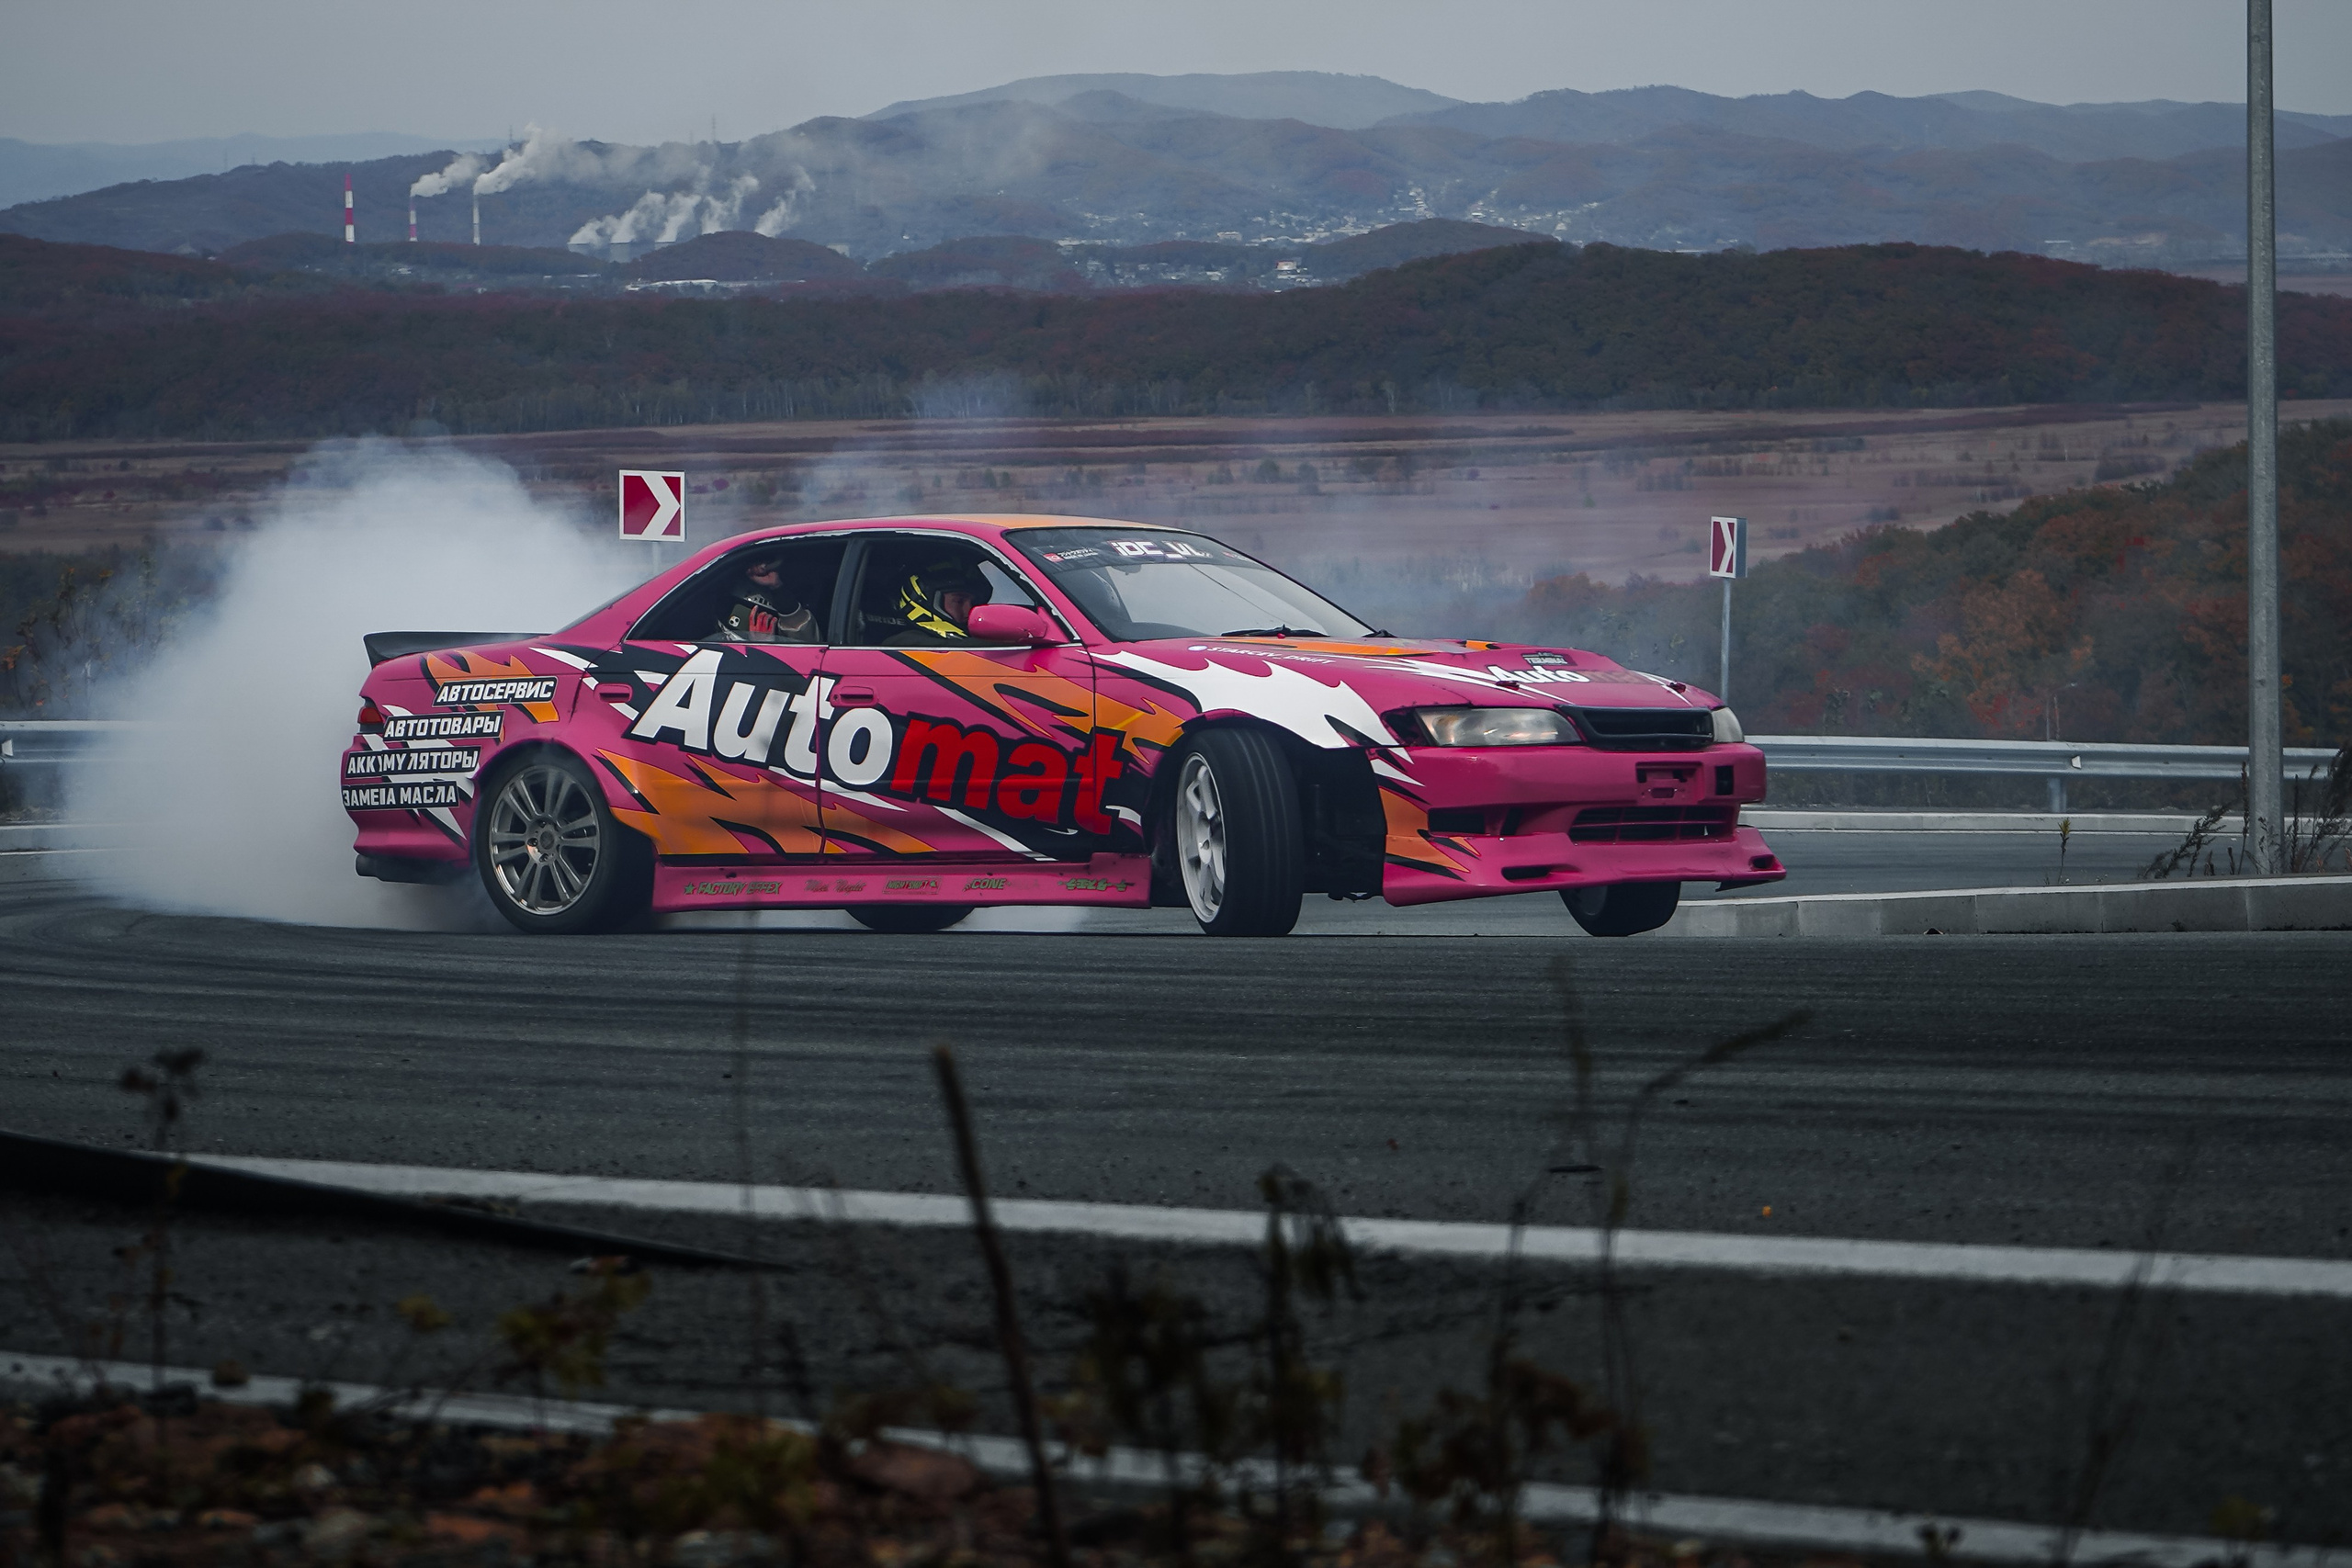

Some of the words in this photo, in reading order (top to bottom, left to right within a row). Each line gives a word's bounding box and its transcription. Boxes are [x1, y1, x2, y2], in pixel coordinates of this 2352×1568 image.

[436, 681, 554, 703] АВТОСЕРВИС
[383, 716, 502, 738] АВТОТОВАРЫ
[630, 649, 1123, 835] Automat
[400, 785, 457, 805] МАСЛА
[697, 882, 747, 896] FACTORY
